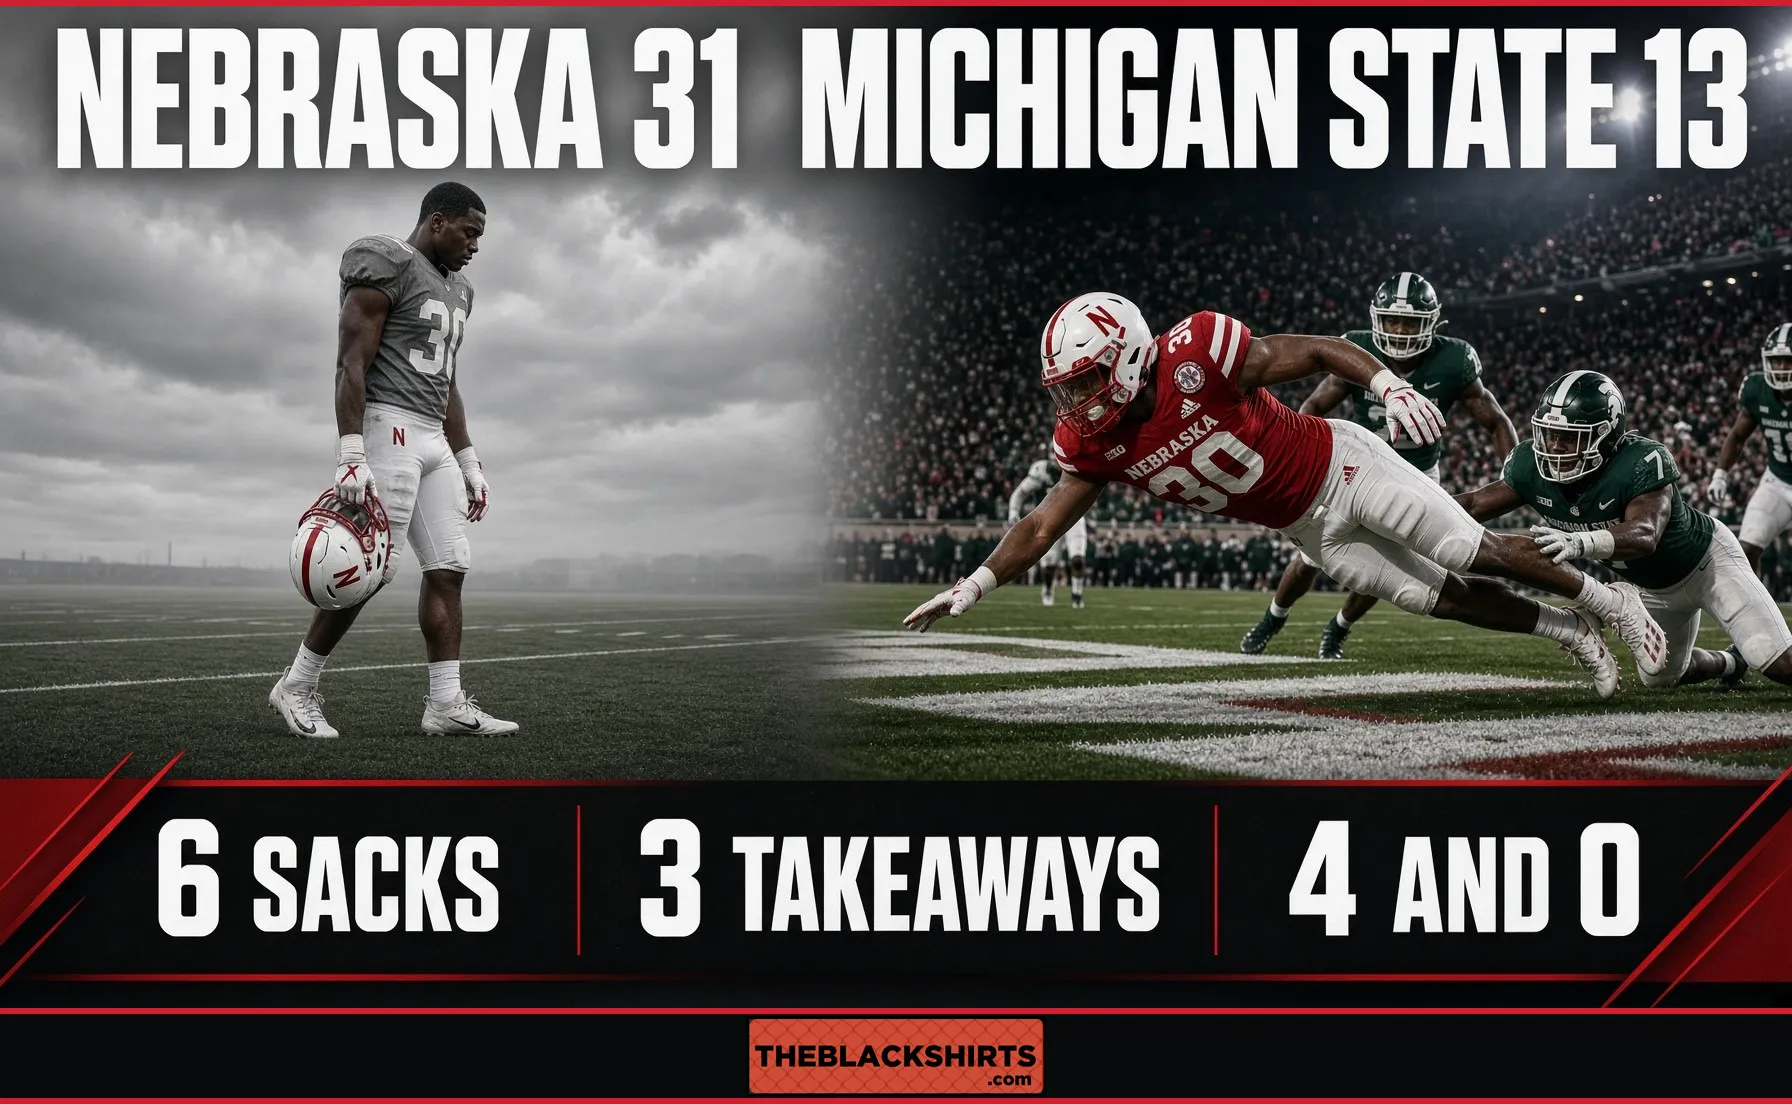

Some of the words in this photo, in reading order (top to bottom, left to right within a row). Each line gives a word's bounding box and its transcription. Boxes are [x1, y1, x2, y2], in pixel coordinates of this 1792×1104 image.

[409, 298, 467, 380] 30
[1085, 305, 1121, 338] N
[1168, 316, 1193, 354] 30
[392, 426, 405, 447] N
[1124, 414, 1219, 480] NEBRASKA
[1148, 431, 1265, 513] 30
[1643, 449, 1665, 480] 7
[332, 565, 361, 590] N
